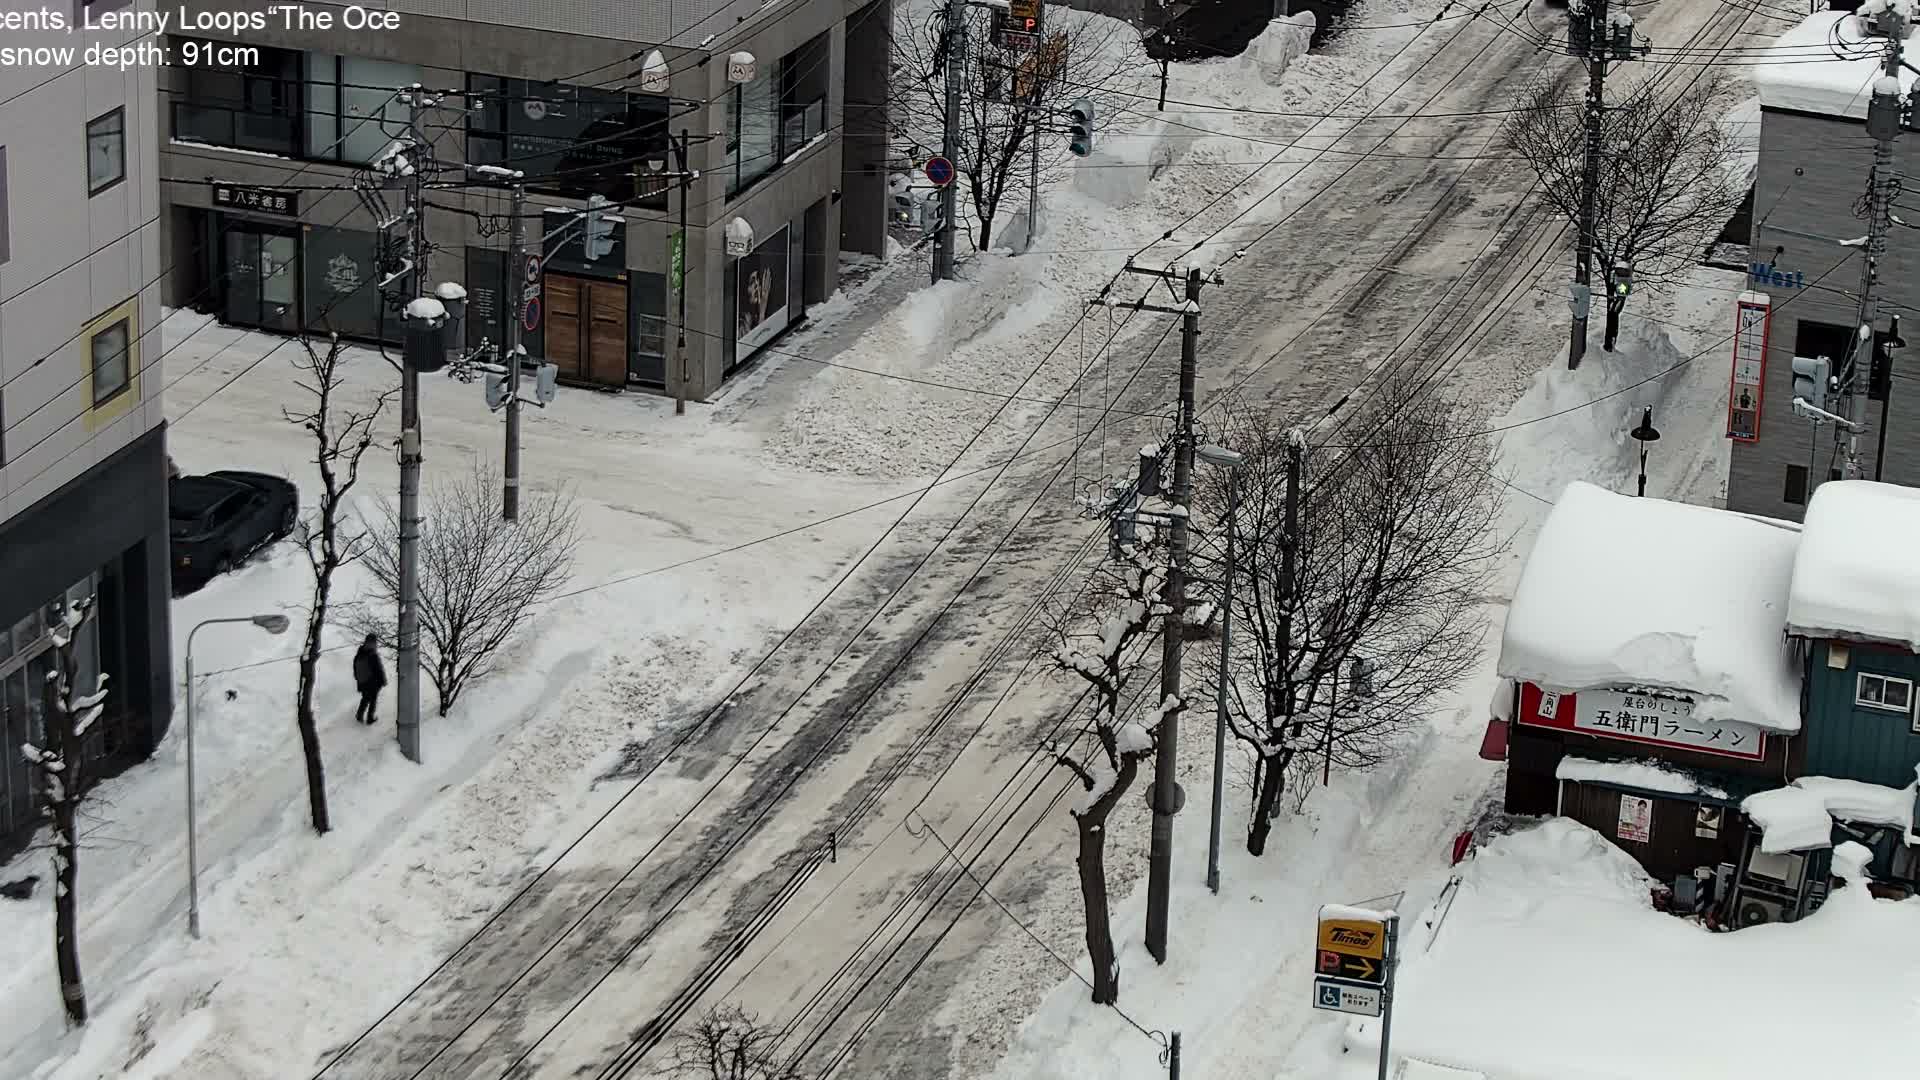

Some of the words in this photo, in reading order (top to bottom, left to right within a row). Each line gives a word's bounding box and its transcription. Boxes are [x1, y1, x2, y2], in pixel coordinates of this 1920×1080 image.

[1025, 18, 1035, 31] P
[1752, 262, 1804, 290] West
[1593, 710, 1745, 746] 五衛門ラーメン
[1330, 926, 1377, 947] Times
[1320, 952, 1340, 972] P
